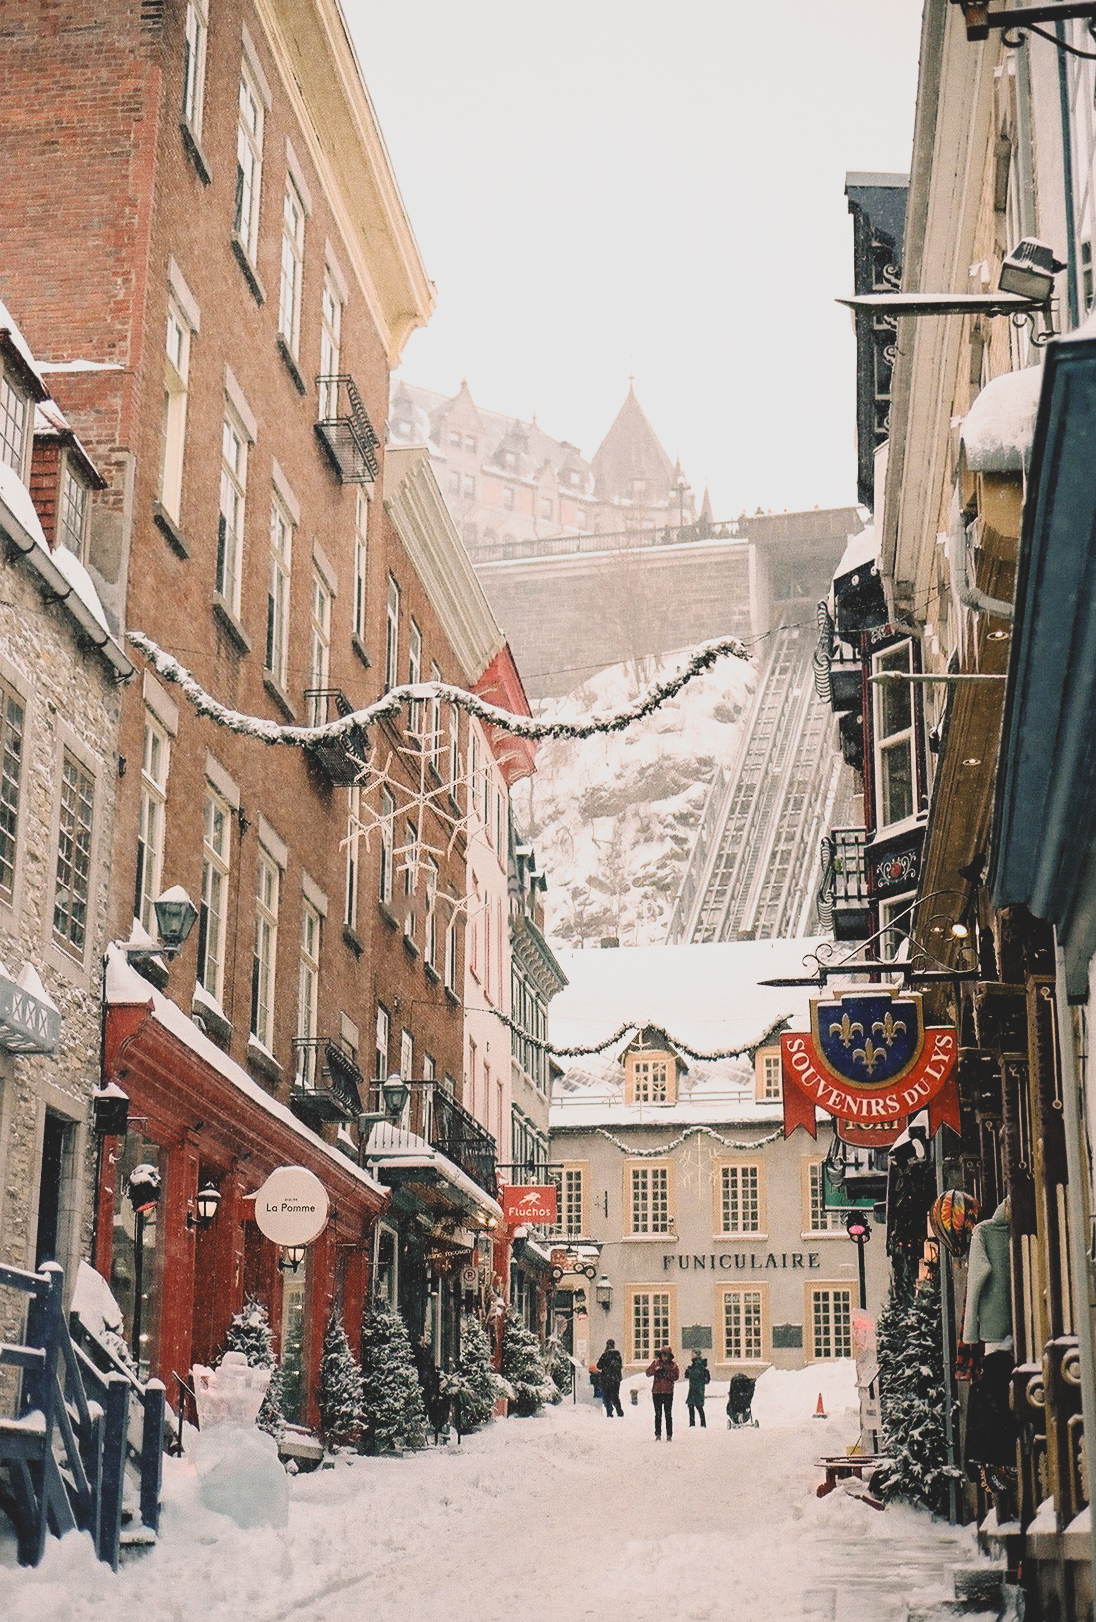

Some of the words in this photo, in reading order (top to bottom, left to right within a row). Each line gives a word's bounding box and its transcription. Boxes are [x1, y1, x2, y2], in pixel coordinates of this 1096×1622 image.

[787, 1038, 900, 1116] SOUVENIRS
[902, 1078, 931, 1106] DU
[925, 1034, 953, 1080] LYS
[266, 1203, 278, 1212] La
[281, 1203, 315, 1212] Pomme
[508, 1207, 551, 1216] Fluchos
[663, 1253, 820, 1270] FUNICULAIRE
